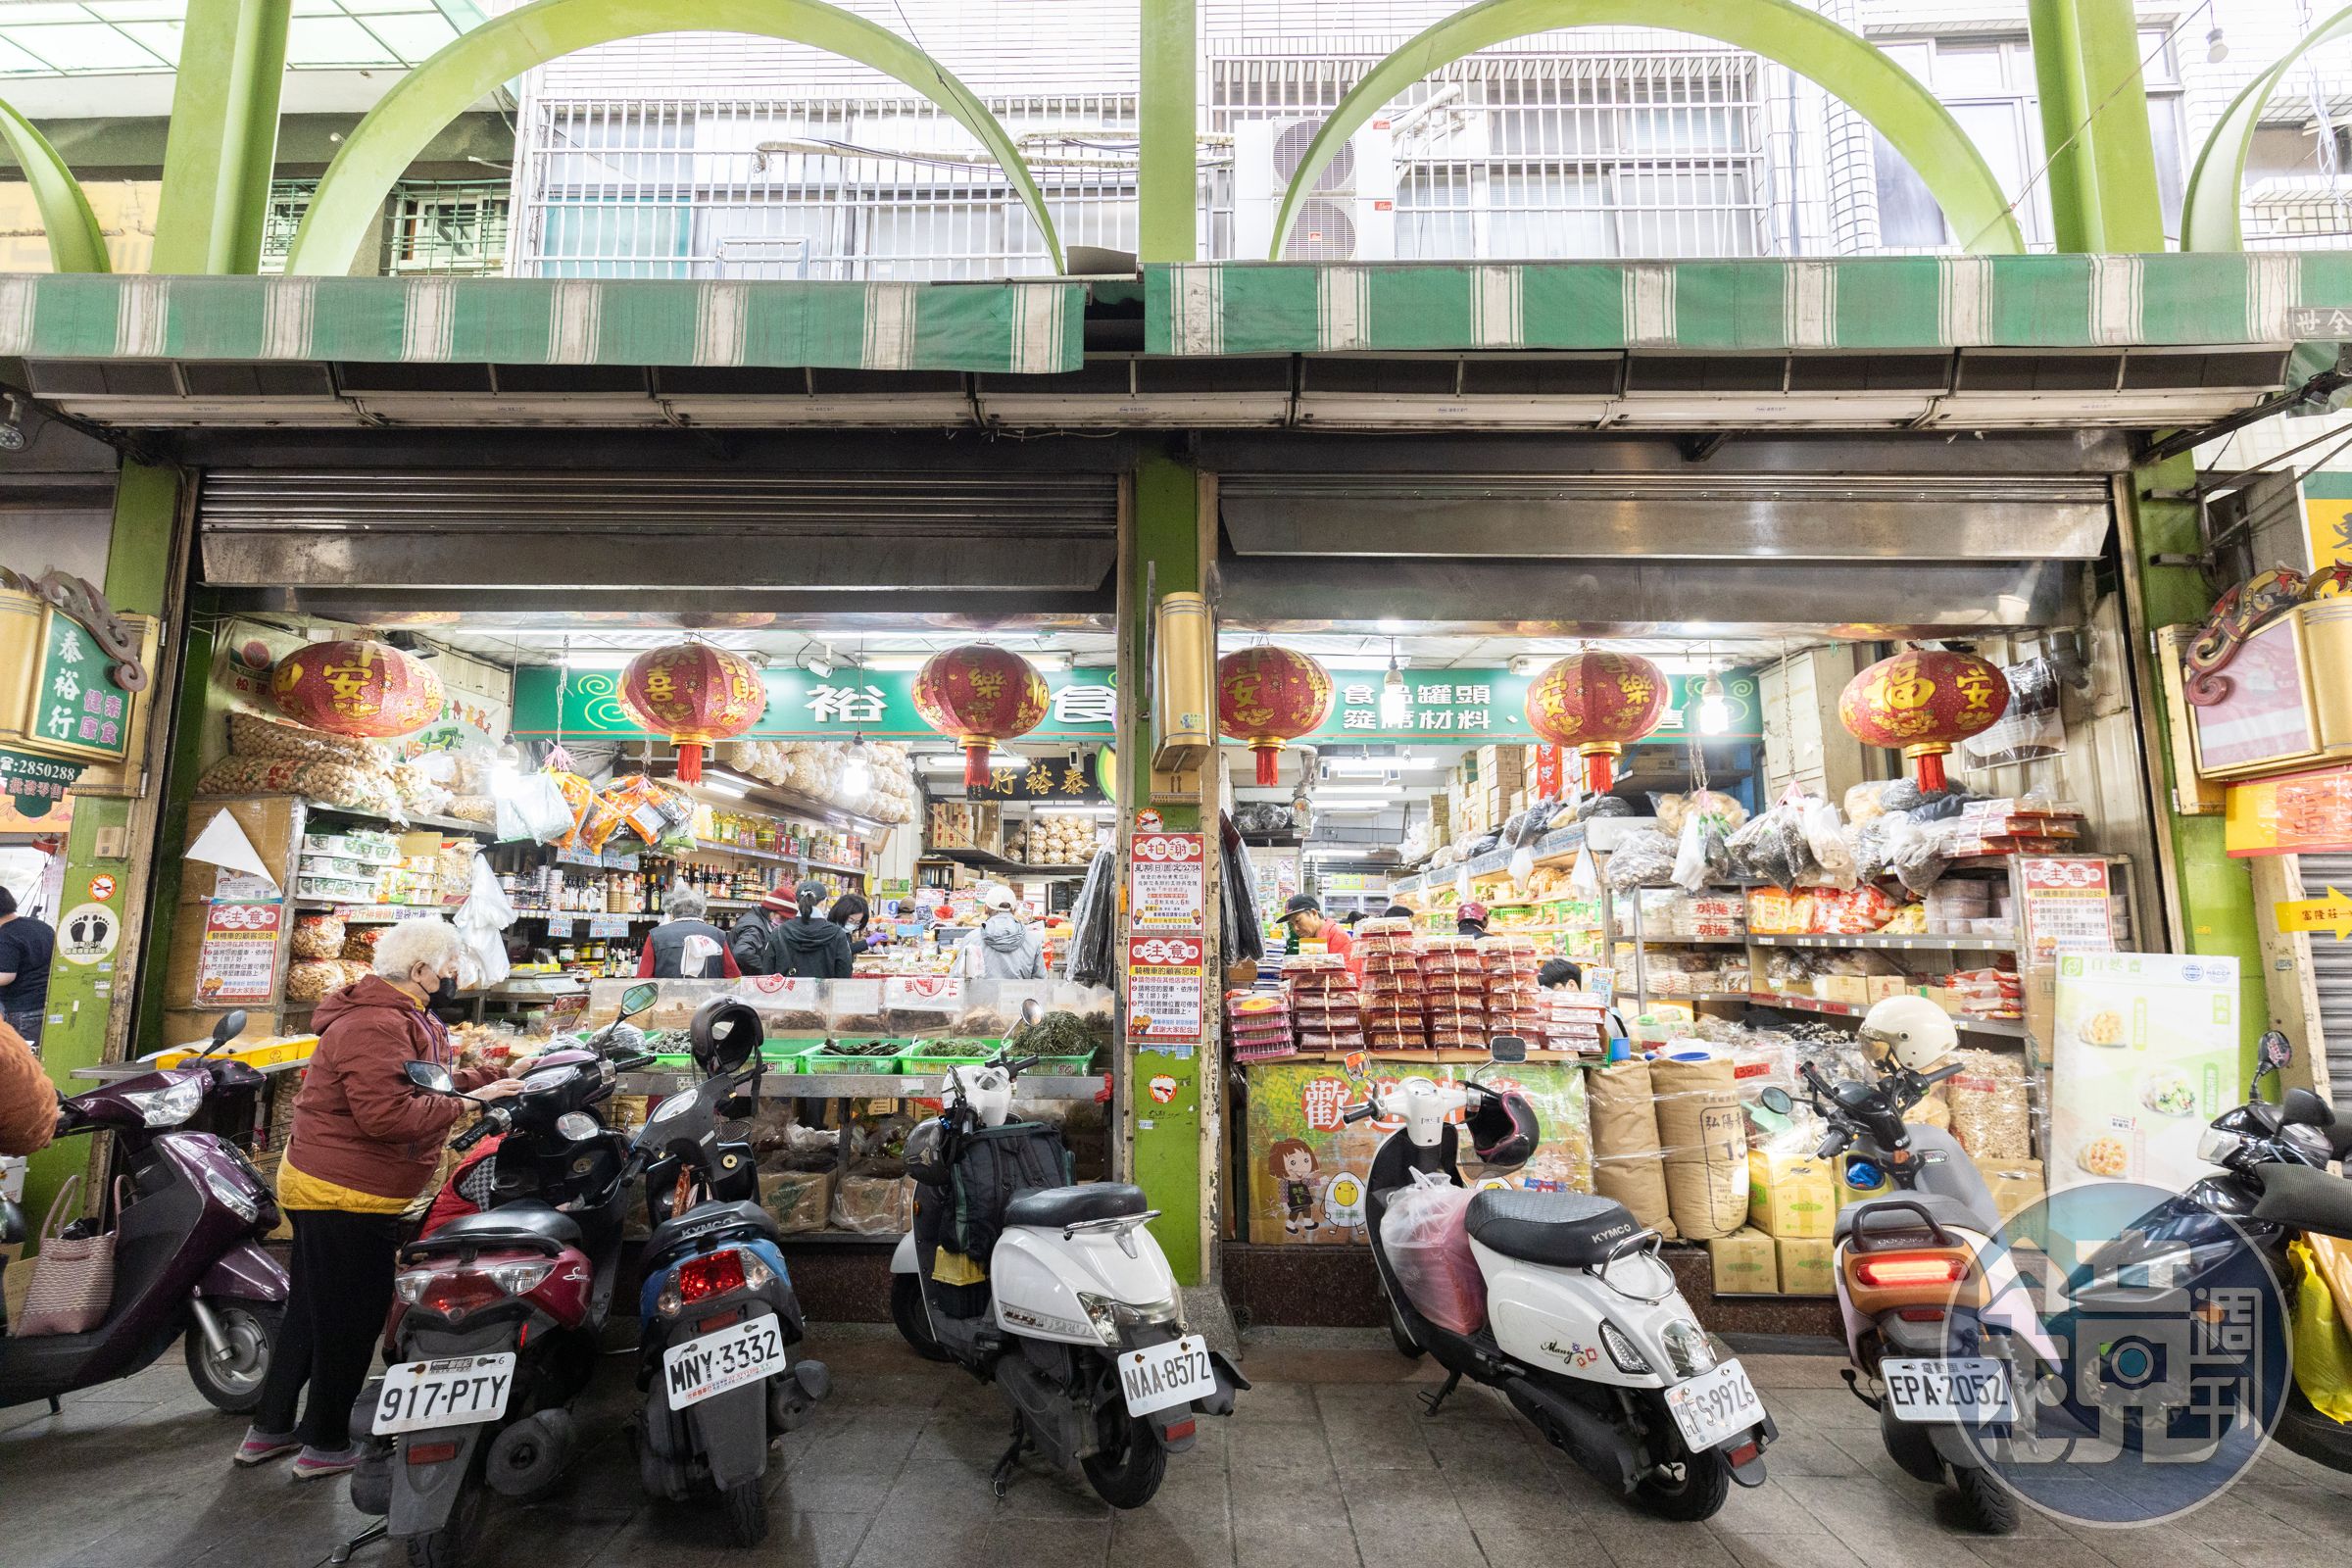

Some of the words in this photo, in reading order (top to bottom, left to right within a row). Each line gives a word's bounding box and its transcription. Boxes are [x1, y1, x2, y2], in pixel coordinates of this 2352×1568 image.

[48, 630, 84, 739] 泰裕行
[78, 688, 103, 740] 健康
[99, 695, 122, 745] 素食
[1134, 966, 1198, 976] 騎機車的顧客您好
[680, 1218, 735, 1238] KYMCO
[1591, 1223, 1632, 1244] KYMCO
